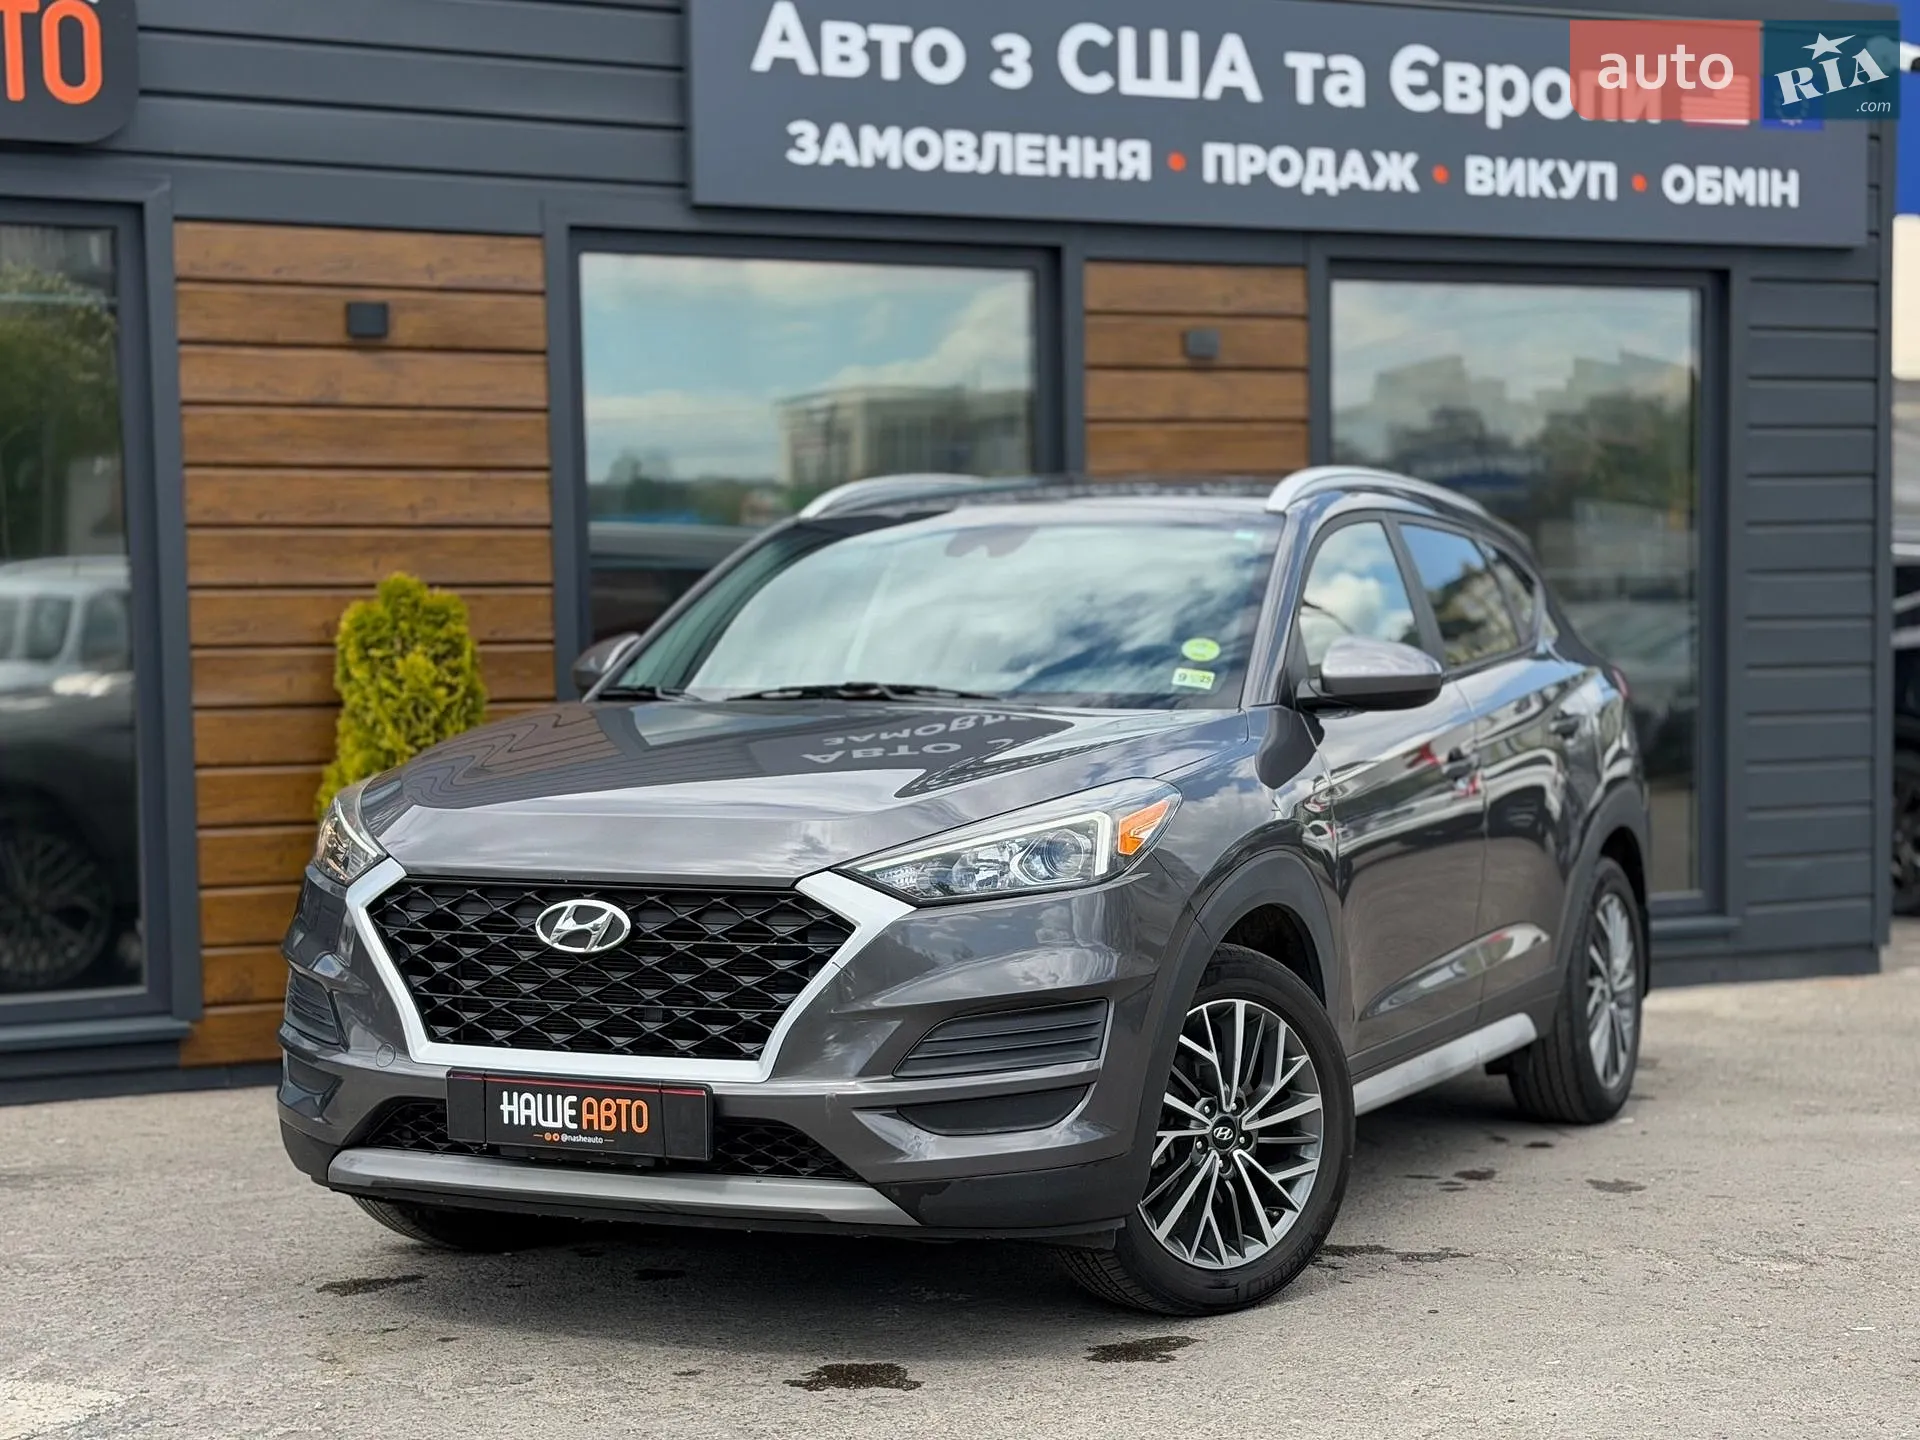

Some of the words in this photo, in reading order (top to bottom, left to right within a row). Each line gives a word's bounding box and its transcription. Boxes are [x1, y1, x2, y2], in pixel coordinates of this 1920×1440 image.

[750, 0, 967, 86] Авто
[989, 32, 1034, 90] з
[1056, 22, 1264, 103] США
[1284, 51, 1366, 108] та
[785, 119, 1153, 183] ЗАМОВЛЕННЯ
[1202, 142, 1420, 197] ПРОДАЖ
[1464, 154, 1619, 202] ВИКУП
[1661, 163, 1800, 208] ОБМІН
[500, 1090, 578, 1130] НАШЕ
[582, 1096, 649, 1134] АВТО
[560, 1132, 604, 1144] @nasheauto
